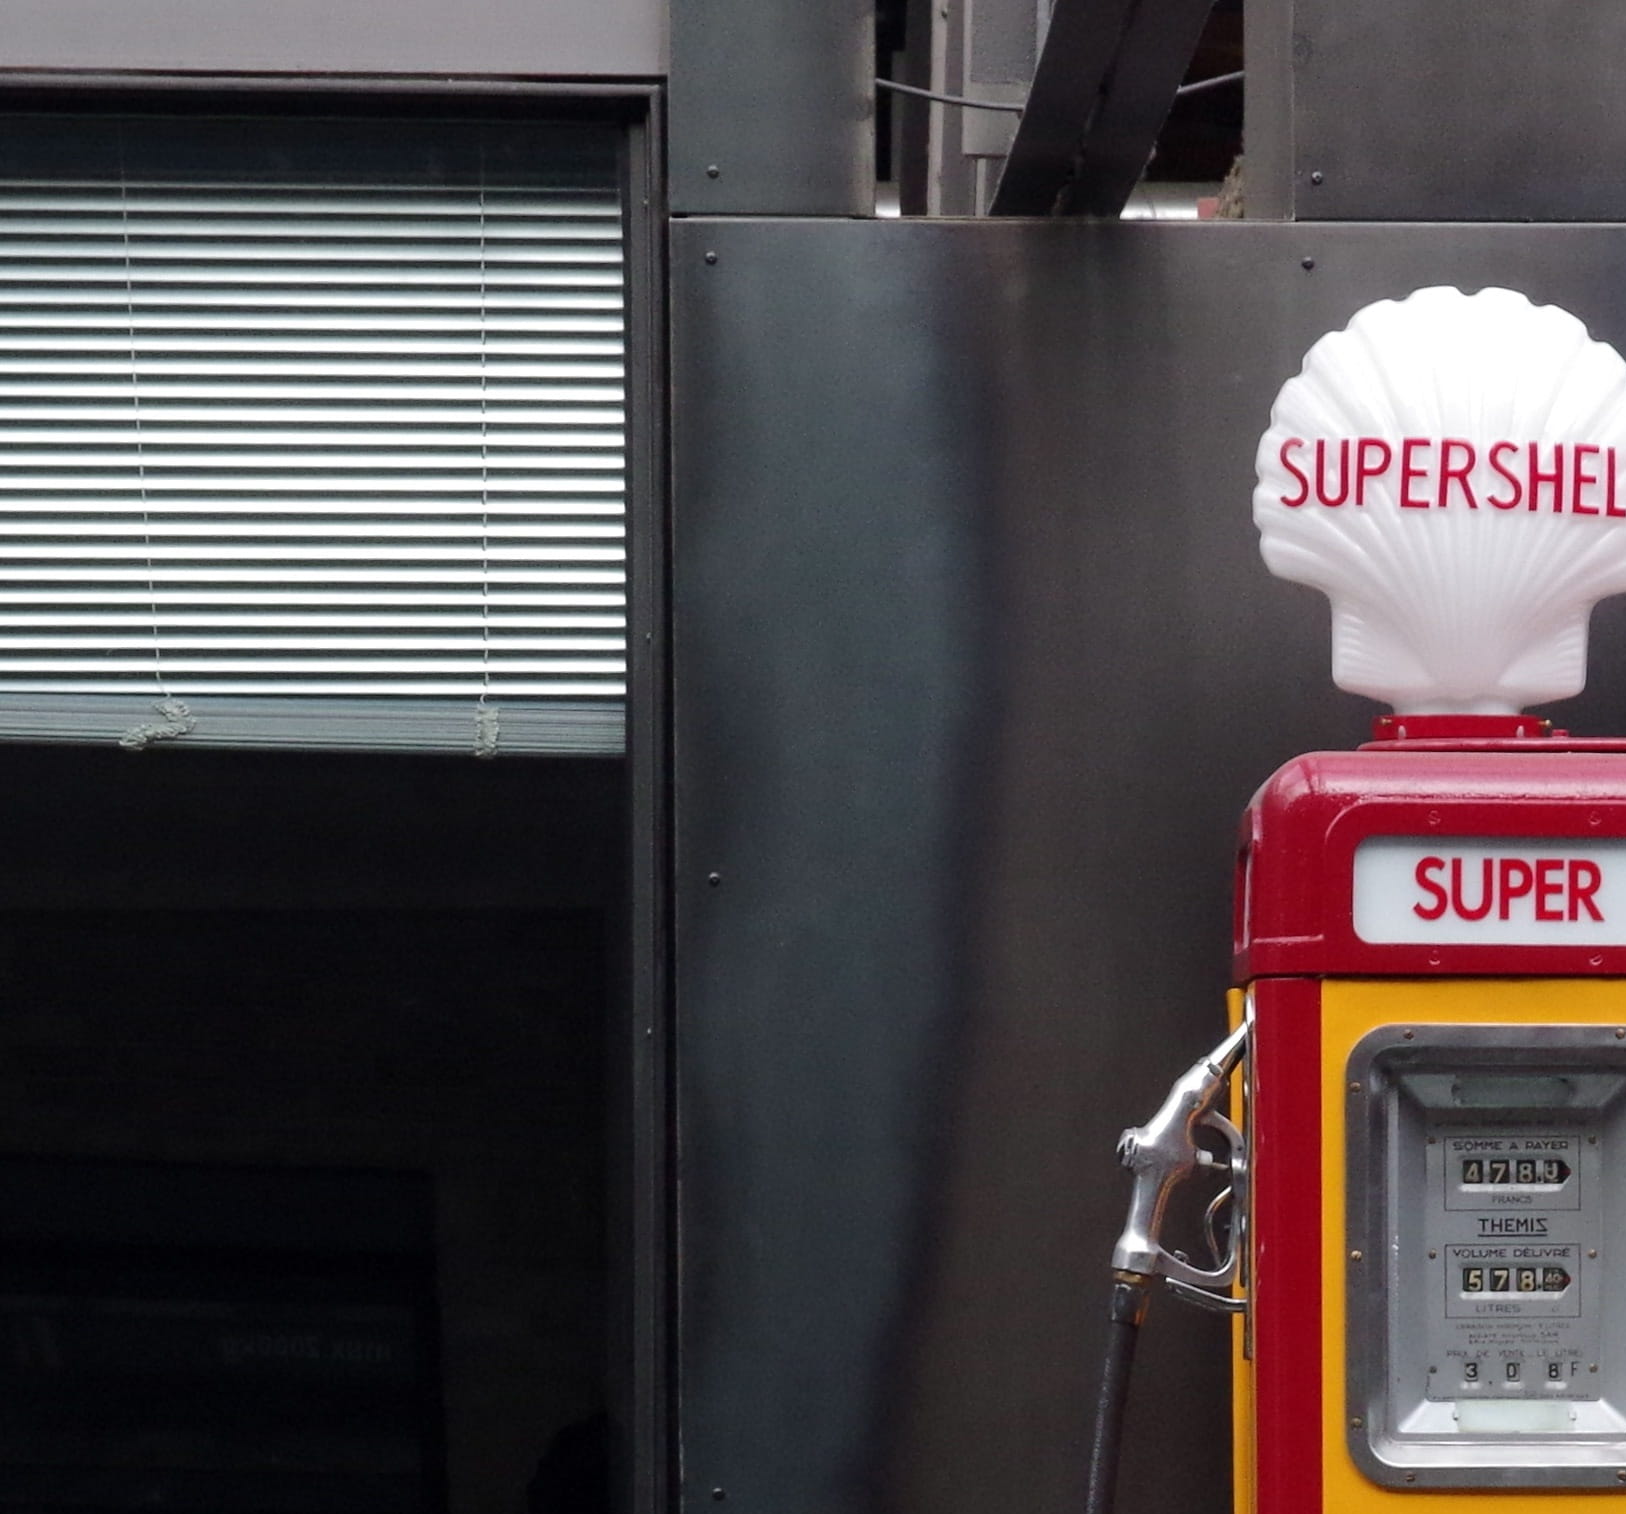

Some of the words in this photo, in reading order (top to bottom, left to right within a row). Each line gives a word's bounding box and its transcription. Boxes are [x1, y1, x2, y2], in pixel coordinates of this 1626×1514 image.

[1413, 856, 1604, 922] SUPER
[1453, 1140, 1503, 1151] SOMME
[1525, 1140, 1569, 1150] PAYER
[1477, 1217, 1549, 1233] THEMIS
[1453, 1248, 1507, 1258] VOLUME
